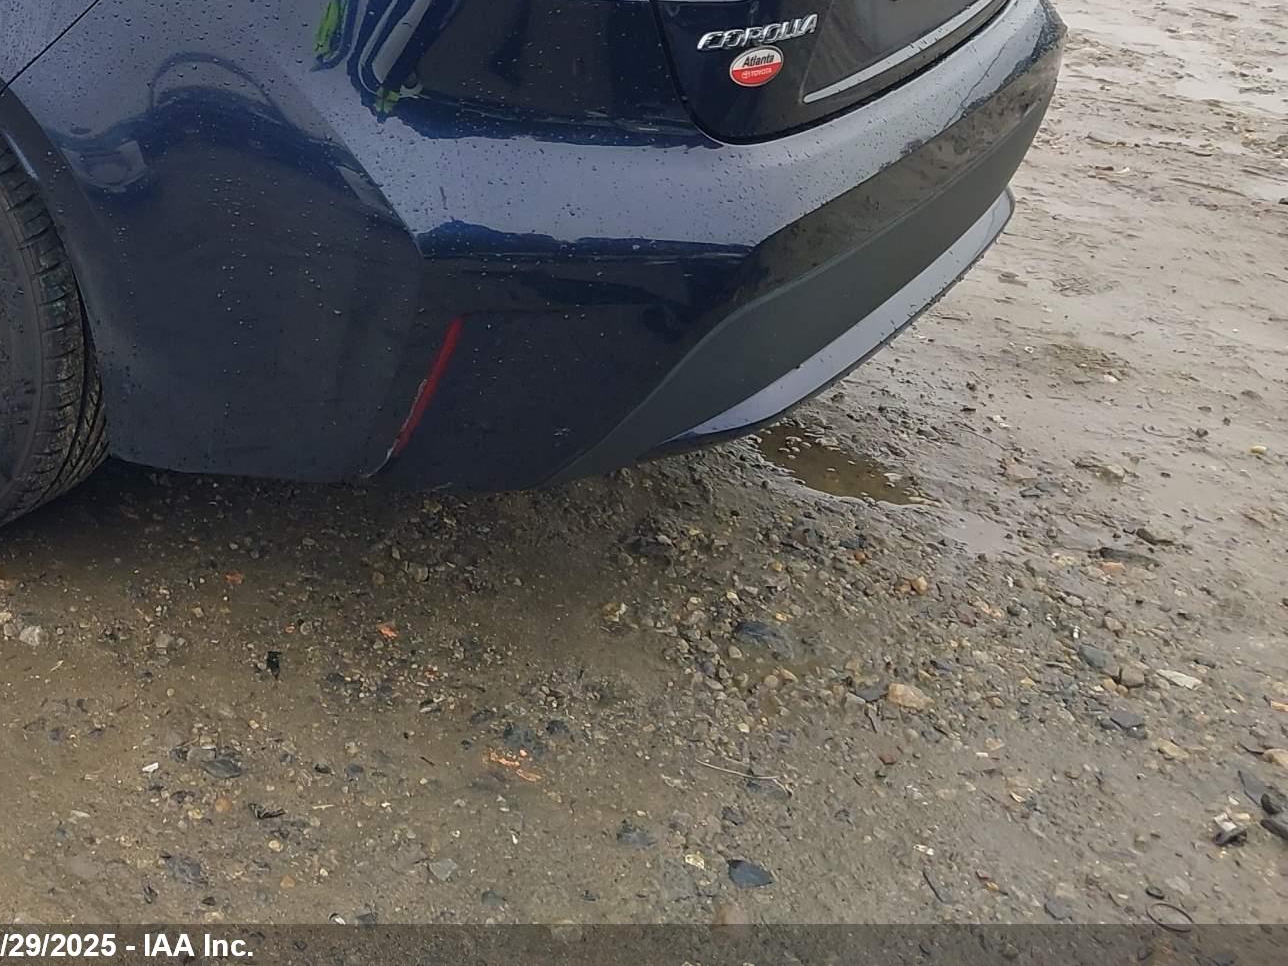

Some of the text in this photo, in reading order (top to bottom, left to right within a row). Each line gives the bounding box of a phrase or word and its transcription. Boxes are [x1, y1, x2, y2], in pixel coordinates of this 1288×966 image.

[696, 13, 818, 50] COROLLA
[742, 53, 775, 68] Atlanta
[751, 68, 772, 77] TOYOTA
